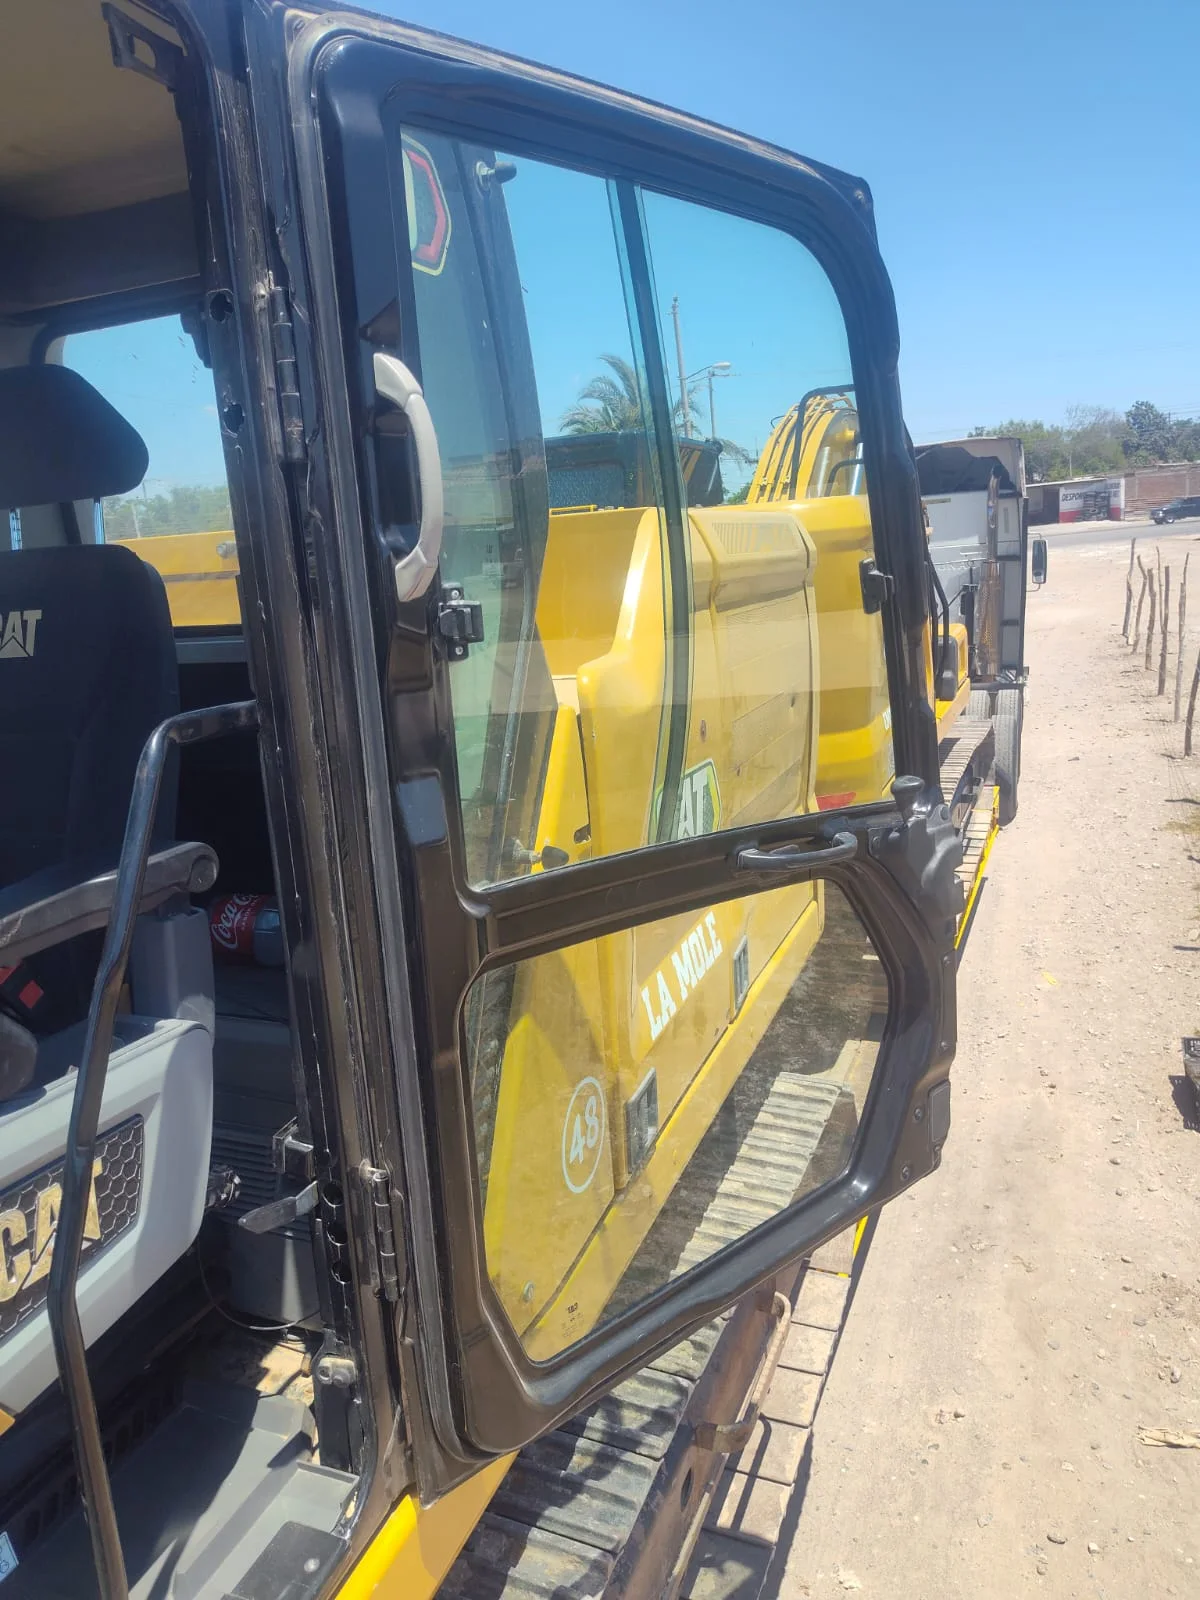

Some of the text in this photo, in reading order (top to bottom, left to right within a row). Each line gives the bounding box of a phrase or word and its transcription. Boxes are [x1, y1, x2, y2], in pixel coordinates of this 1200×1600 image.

[0, 609, 42, 658] AT
[656, 766, 708, 840] AT
[641, 911, 723, 1041] LA MOLE
[569, 1096, 599, 1164] 48
